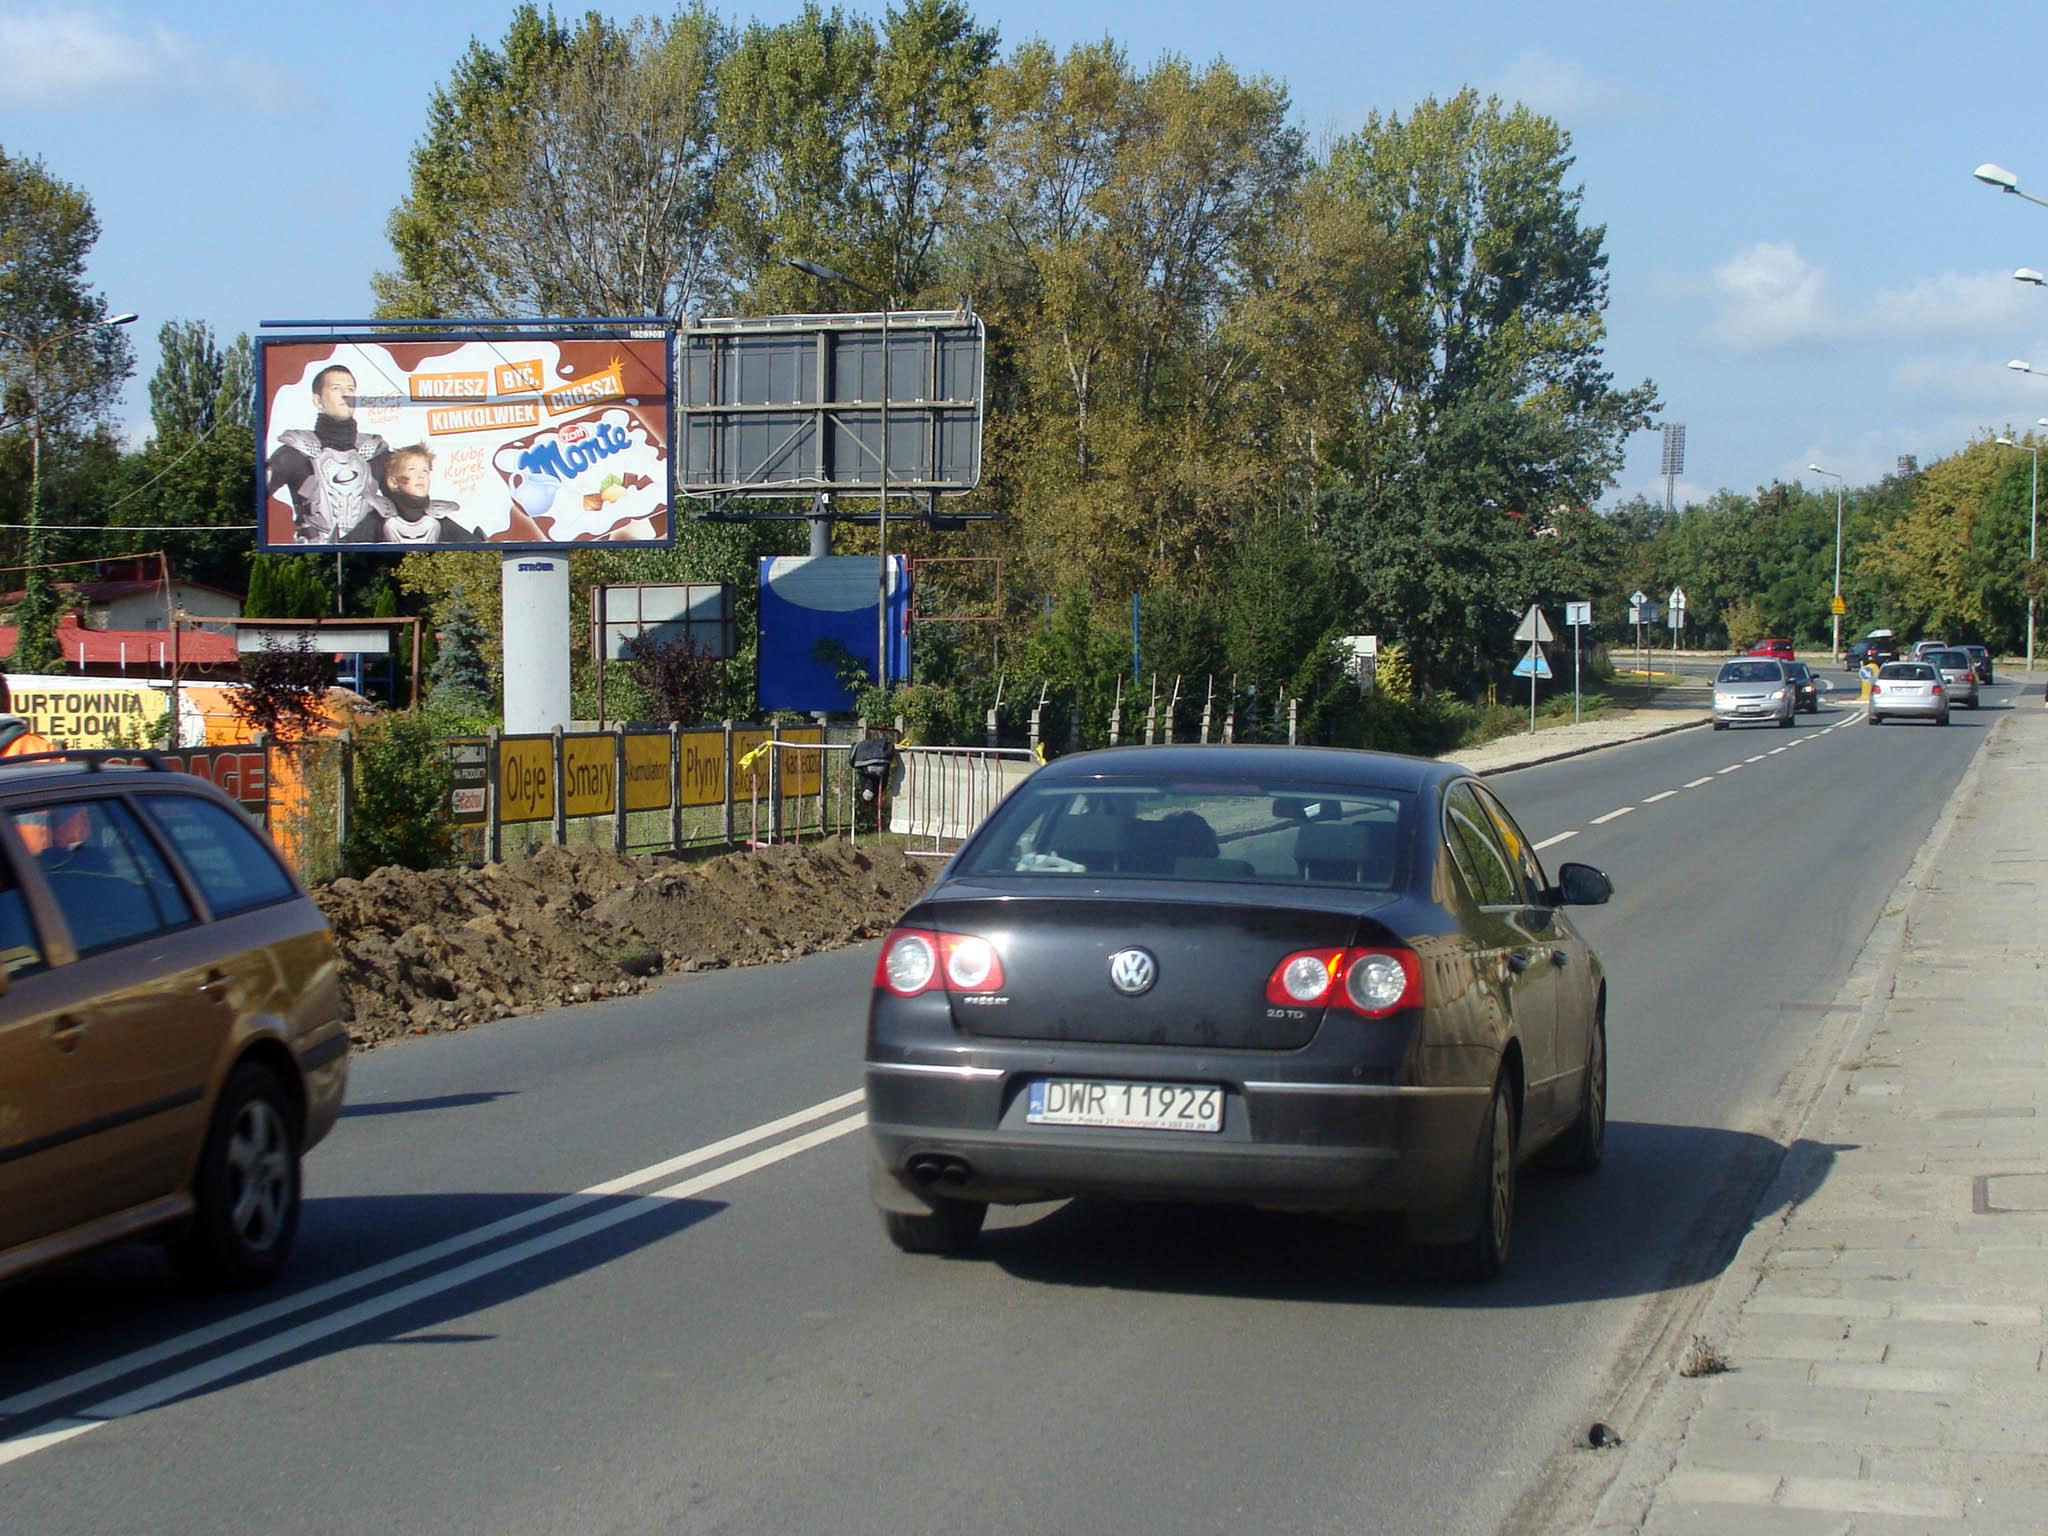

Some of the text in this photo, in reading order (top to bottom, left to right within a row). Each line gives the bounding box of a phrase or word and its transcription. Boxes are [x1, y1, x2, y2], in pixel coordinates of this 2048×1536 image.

[417, 374, 485, 397] MOŻESZ
[431, 375, 620, 431] KIMKOLWIEK CHCESZ!
[517, 422, 632, 481] Monte
[14, 694, 144, 714] URTOWNIA
[506, 754, 546, 814] Oleje
[567, 753, 614, 806] Smary
[1046, 1082, 1216, 1120] DWR 11926
